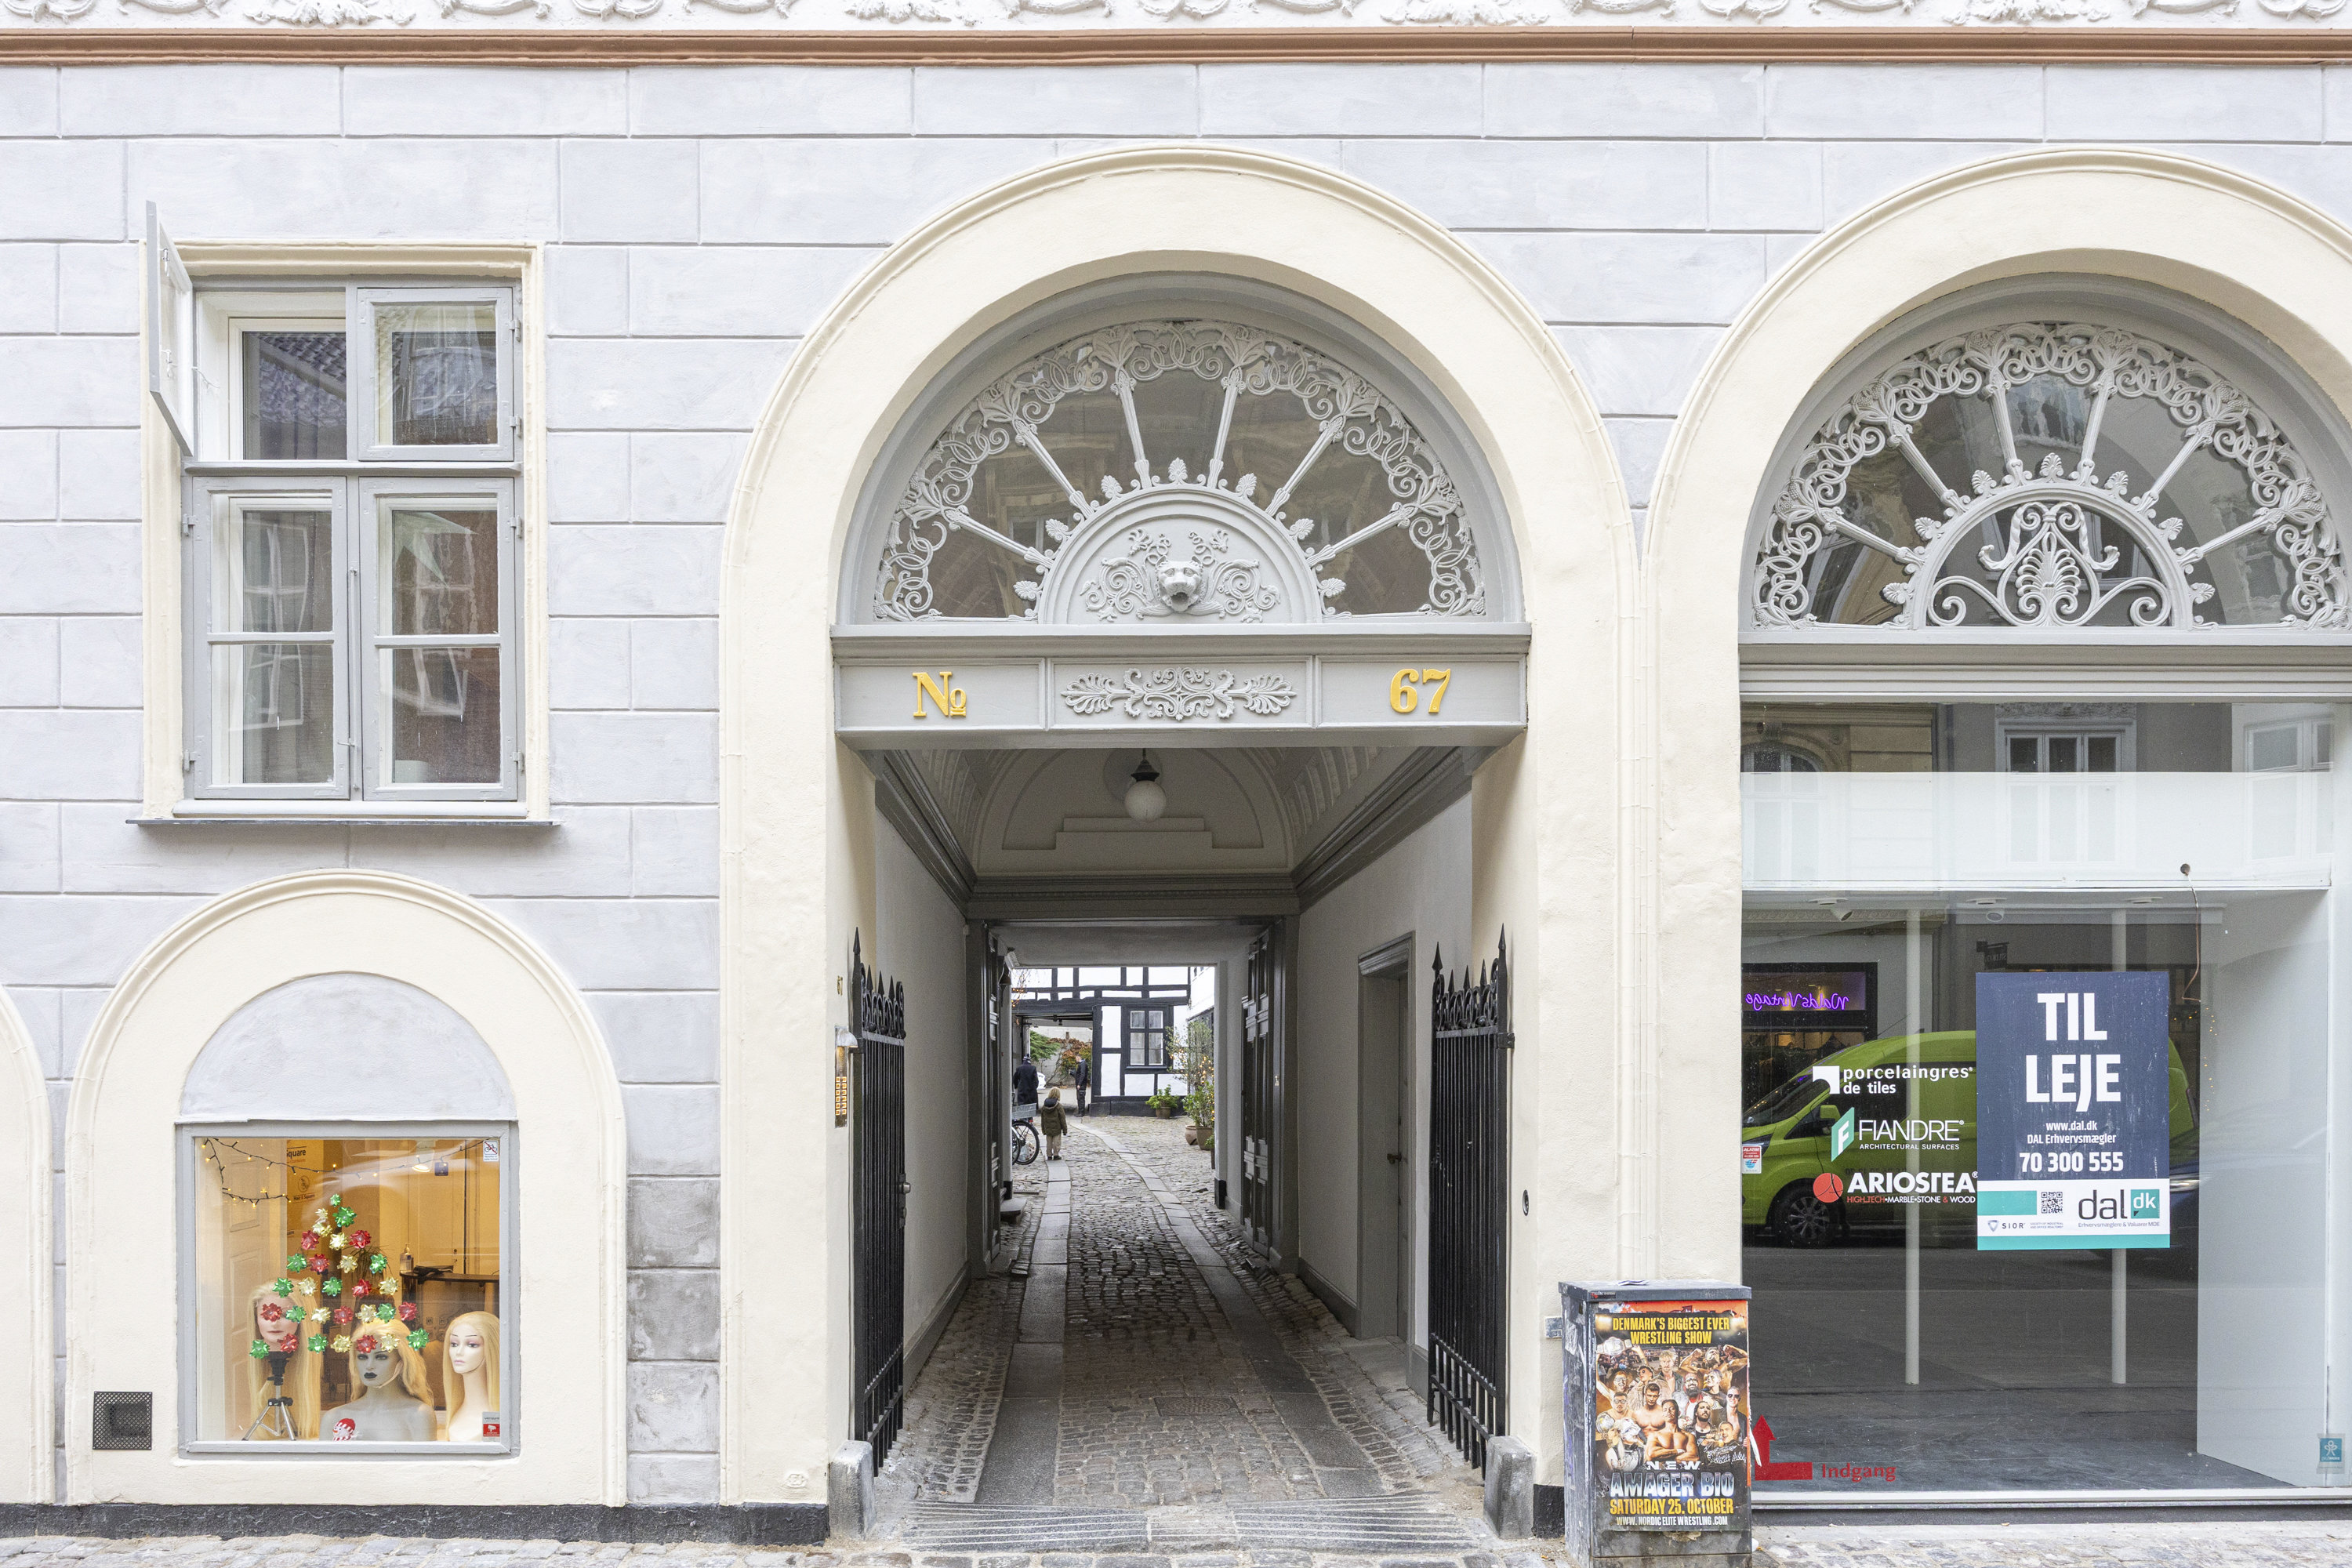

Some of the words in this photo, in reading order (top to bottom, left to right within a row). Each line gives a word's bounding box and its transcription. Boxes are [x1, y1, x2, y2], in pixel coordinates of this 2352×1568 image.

[1390, 668, 1451, 713] 67
[2037, 993, 2108, 1041] TIL
[1842, 1081, 1860, 1094] de
[1867, 1080, 1896, 1094] tiles
[2026, 1054, 2122, 1112] LEJE
[2045, 1120, 2098, 1131] www.dal.dk
[2027, 1134, 2044, 1145] DAL
[2045, 1133, 2117, 1145] Erhvervsmægler
[2019, 1152, 2043, 1173] 70
[2047, 1152, 2084, 1173] 300
[2089, 1151, 2124, 1172] 555
[2078, 1189, 2128, 1220] dal
[2132, 1192, 2157, 1209] dk
[1612, 1317, 1666, 1331] DENMARK'S
[1668, 1317, 1704, 1330] BIGGEST
[1707, 1316, 1730, 1330] EVER
[1630, 1331, 1682, 1345] WRESTLING
[1684, 1331, 1712, 1345] SHOW
[1822, 1462, 1896, 1483] Indgang
[1610, 1472, 1694, 1497] AMAGER
[1700, 1471, 1735, 1497] BIO
[1610, 1498, 1666, 1515] SATURDAY
[1668, 1498, 1685, 1515] 25.
[1686, 1497, 1734, 1515] OCTOBER
